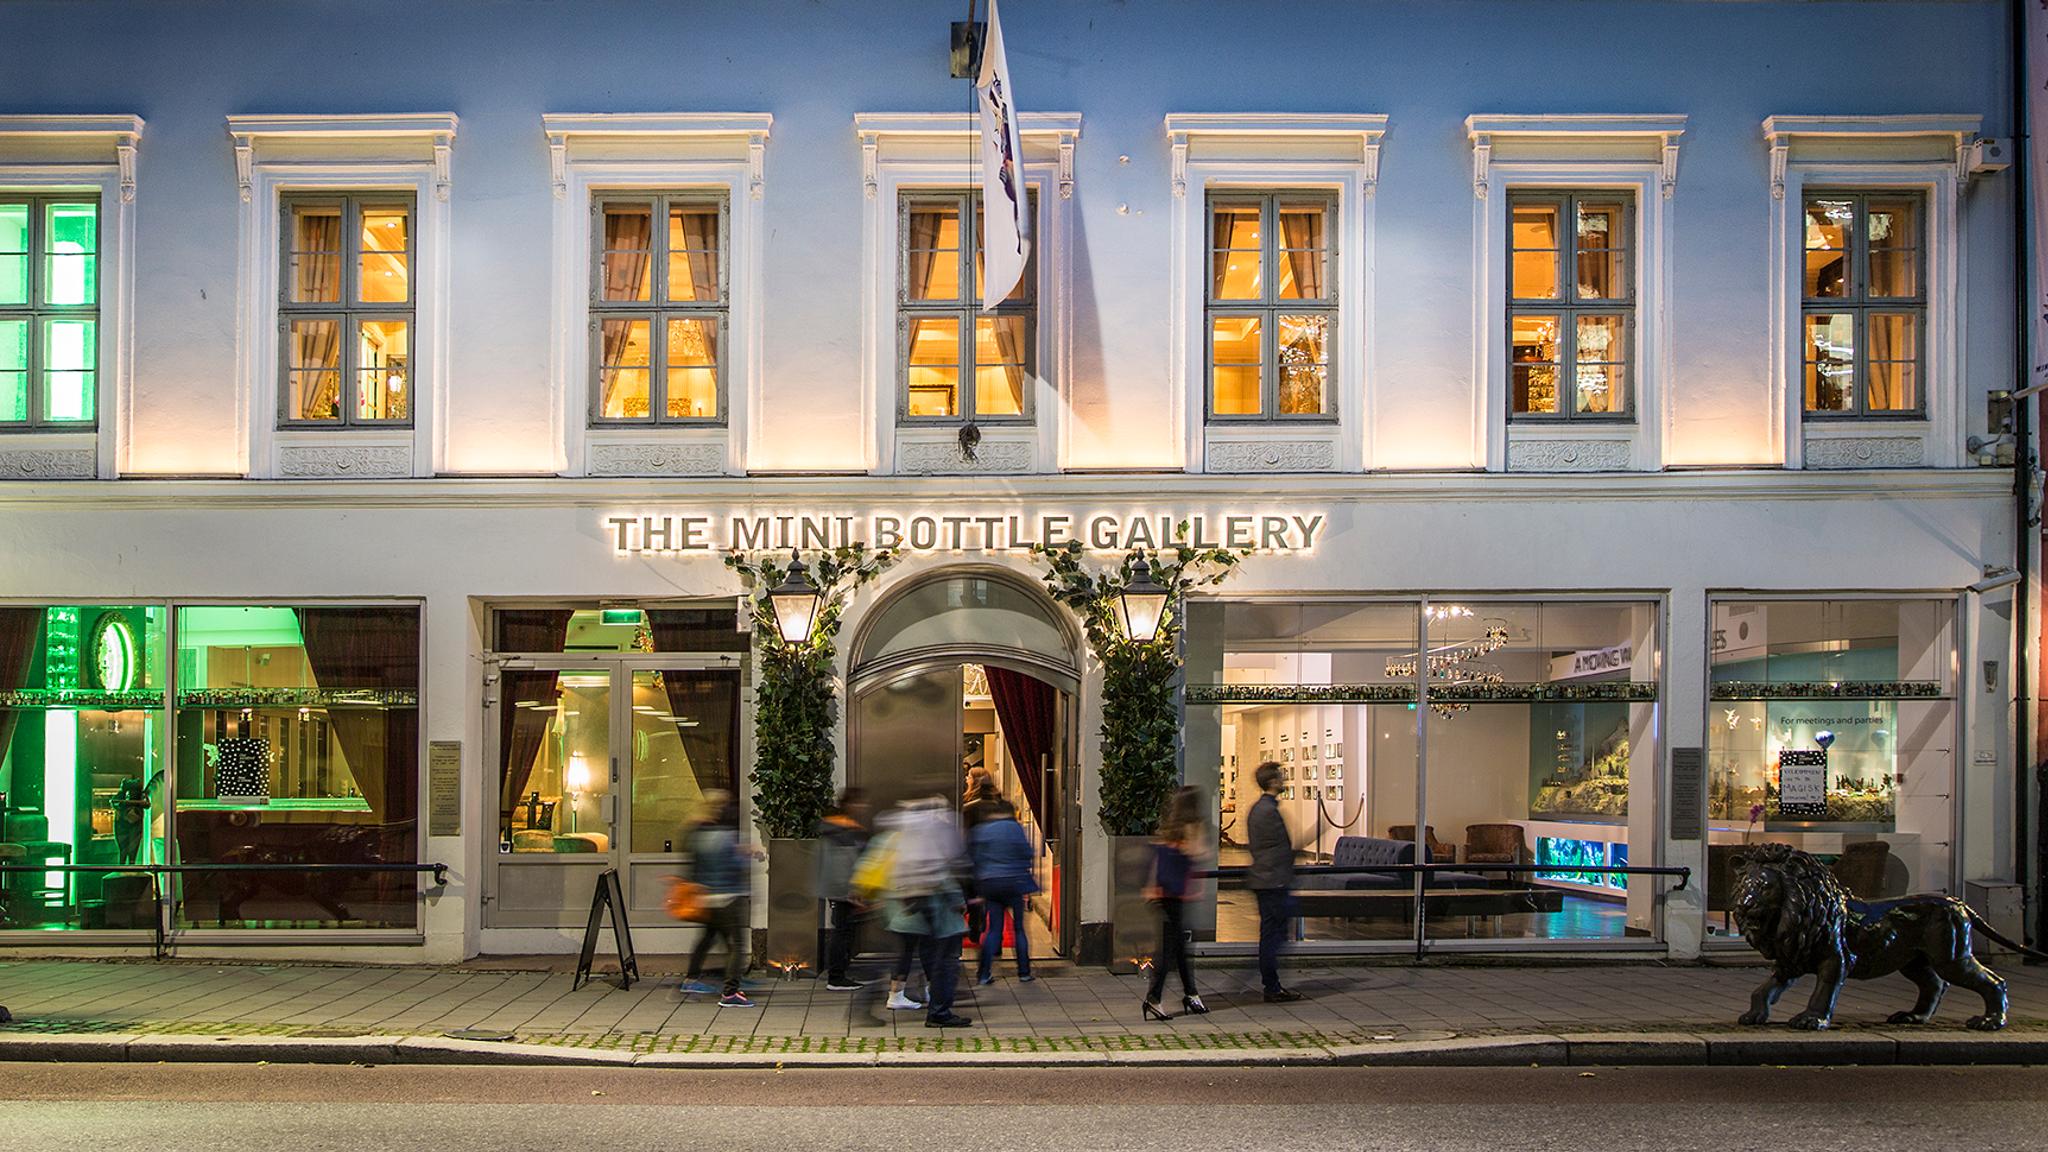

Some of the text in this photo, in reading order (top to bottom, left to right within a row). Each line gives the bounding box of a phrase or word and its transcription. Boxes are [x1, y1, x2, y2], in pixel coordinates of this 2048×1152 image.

[608, 515, 1323, 550] THE MINI BOTTLE GALLERY
[1780, 716, 1884, 726] For meetings and parties
